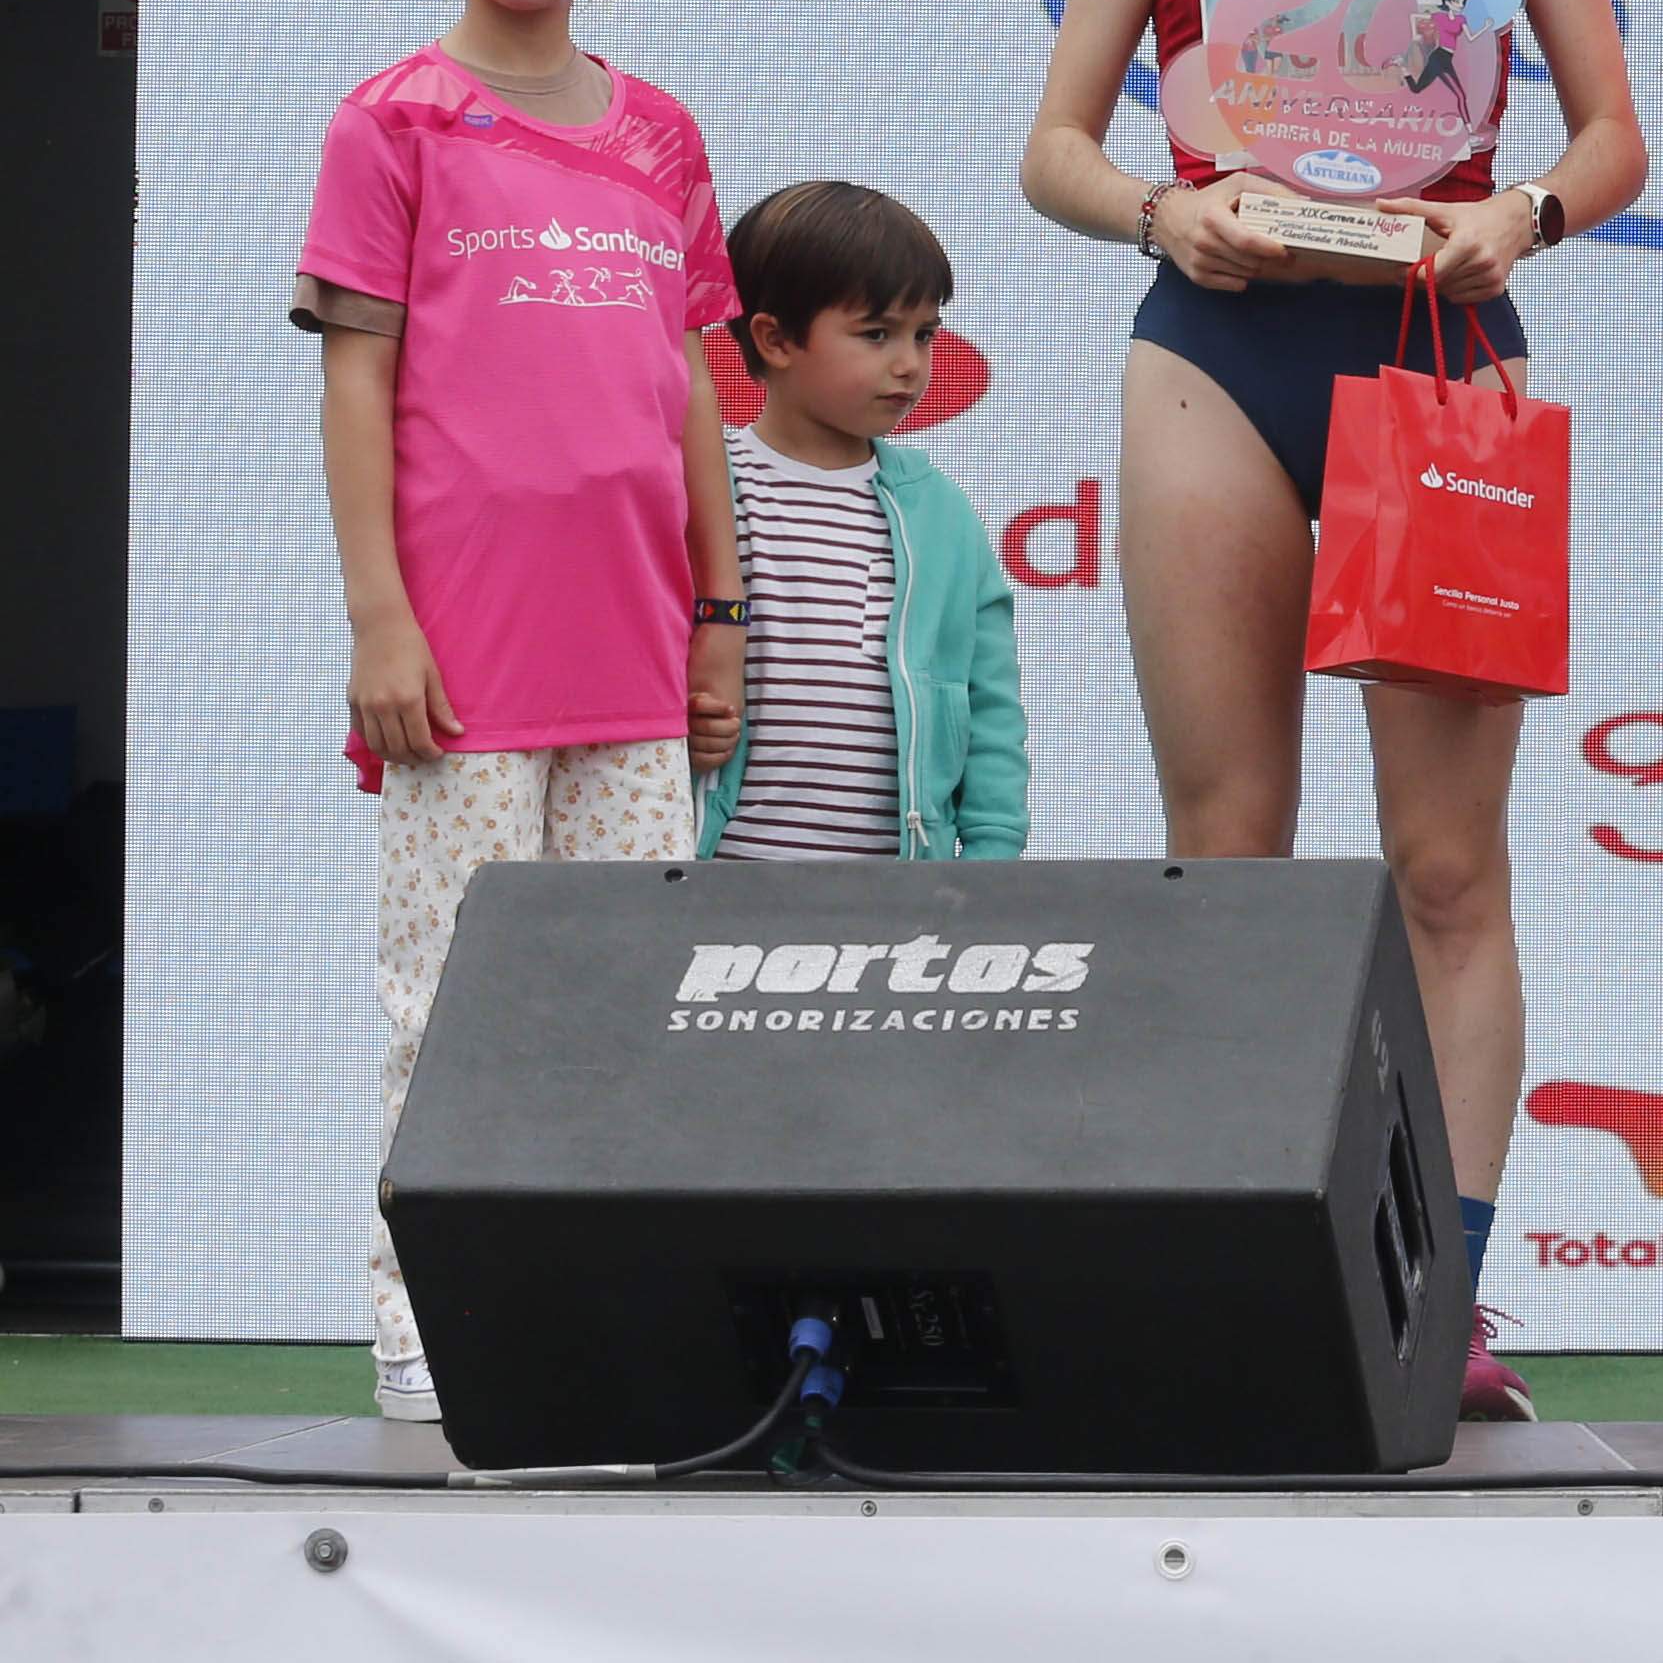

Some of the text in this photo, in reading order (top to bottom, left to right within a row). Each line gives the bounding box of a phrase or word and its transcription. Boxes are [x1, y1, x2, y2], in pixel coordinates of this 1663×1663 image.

[1328, 131, 1350, 147] DE
[1384, 139, 1443, 161] MUJER
[1301, 161, 1375, 185] ASTURIANA
[1297, 207, 1320, 219] XIX
[1320, 210, 1356, 224] Carrera
[1373, 217, 1411, 238] Mujer
[448, 225, 535, 259] Sports
[1446, 472, 1535, 509] Santander
[674, 933, 1096, 1003] portos
[666, 1008, 1081, 1032] SONORIZACIONES
